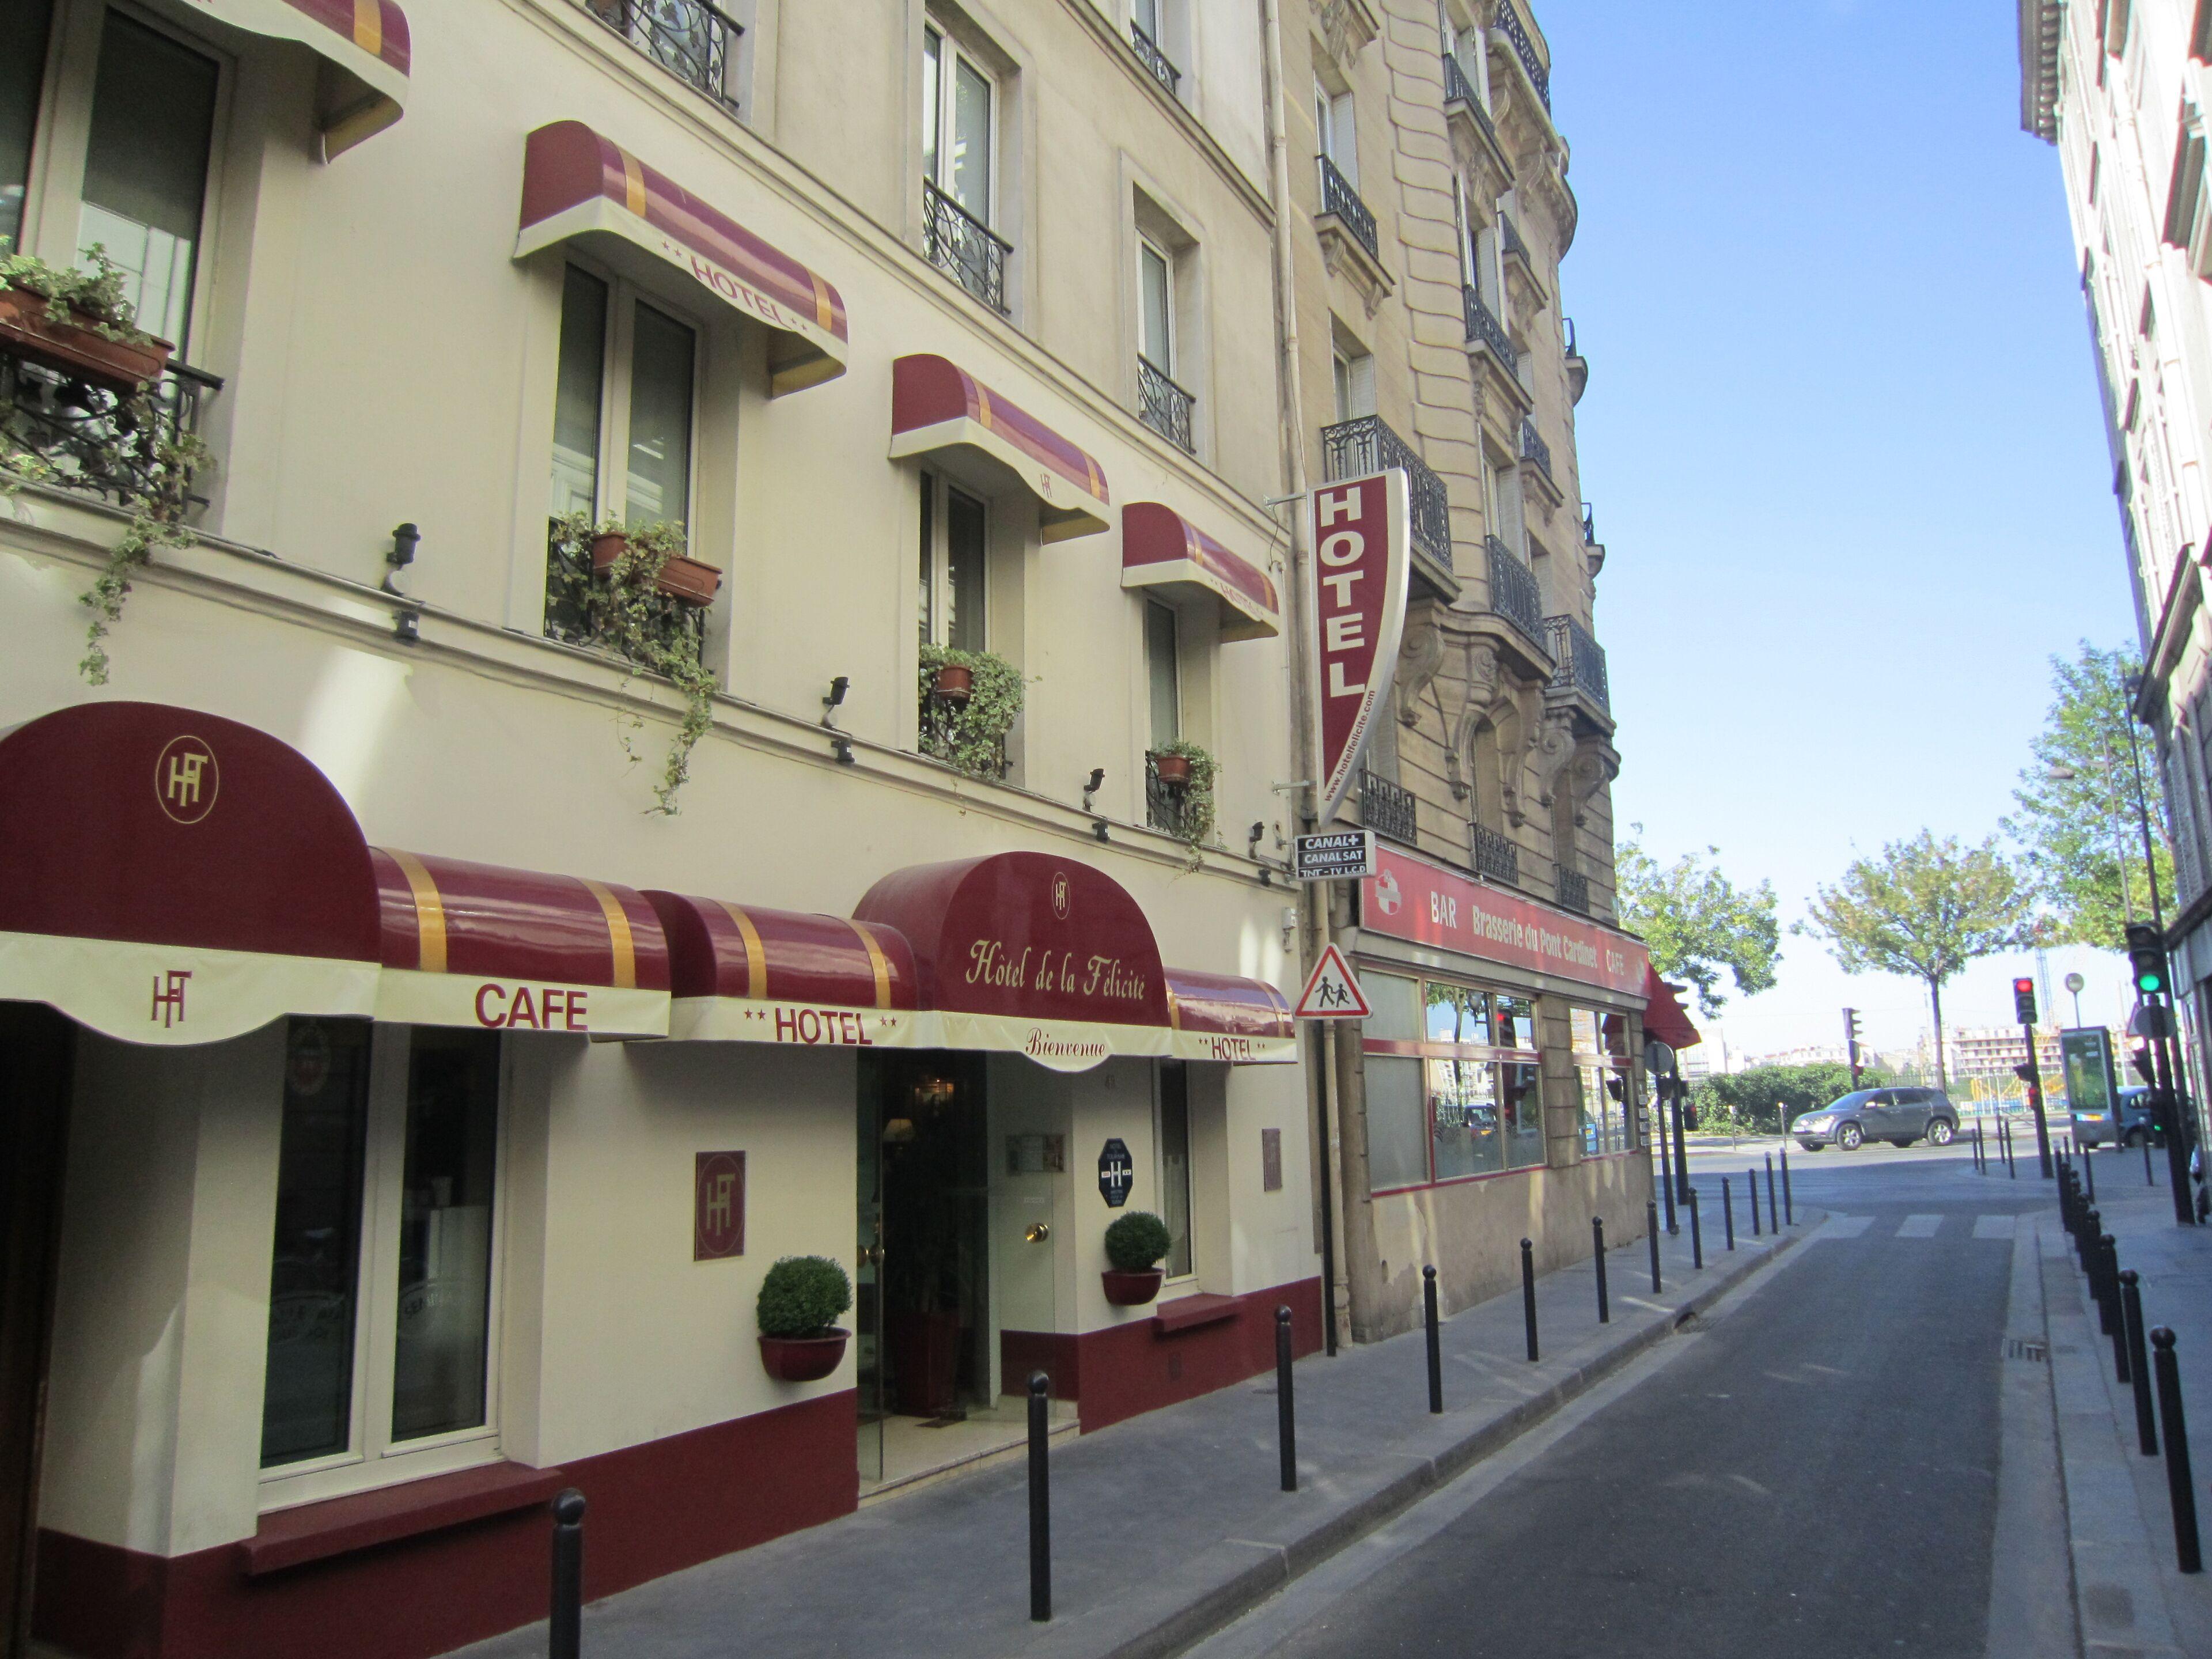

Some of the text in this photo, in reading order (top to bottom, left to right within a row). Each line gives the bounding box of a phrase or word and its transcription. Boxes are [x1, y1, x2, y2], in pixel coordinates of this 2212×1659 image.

[690, 255, 792, 330] HOTEL
[1320, 486, 1366, 698] HOTEL
[1325, 690, 1376, 801] www.hotelfelicite.com
[1305, 835, 1359, 850] CANAL+
[1300, 868, 1323, 877] TNT
[1330, 866, 1342, 876] TV
[1431, 891, 1457, 929] BAR
[1472, 905, 1598, 968] Brasserie du Pont Cardinet
[965, 940, 1145, 1000] Hôtel de la Félicité
[475, 983, 589, 1032] CAFE
[775, 1007, 873, 1046] HOTEL
[1025, 1027, 1105, 1057] Bienvenue
[1211, 1036, 1256, 1060] HOTEL
[1110, 1161, 1123, 1188] H
